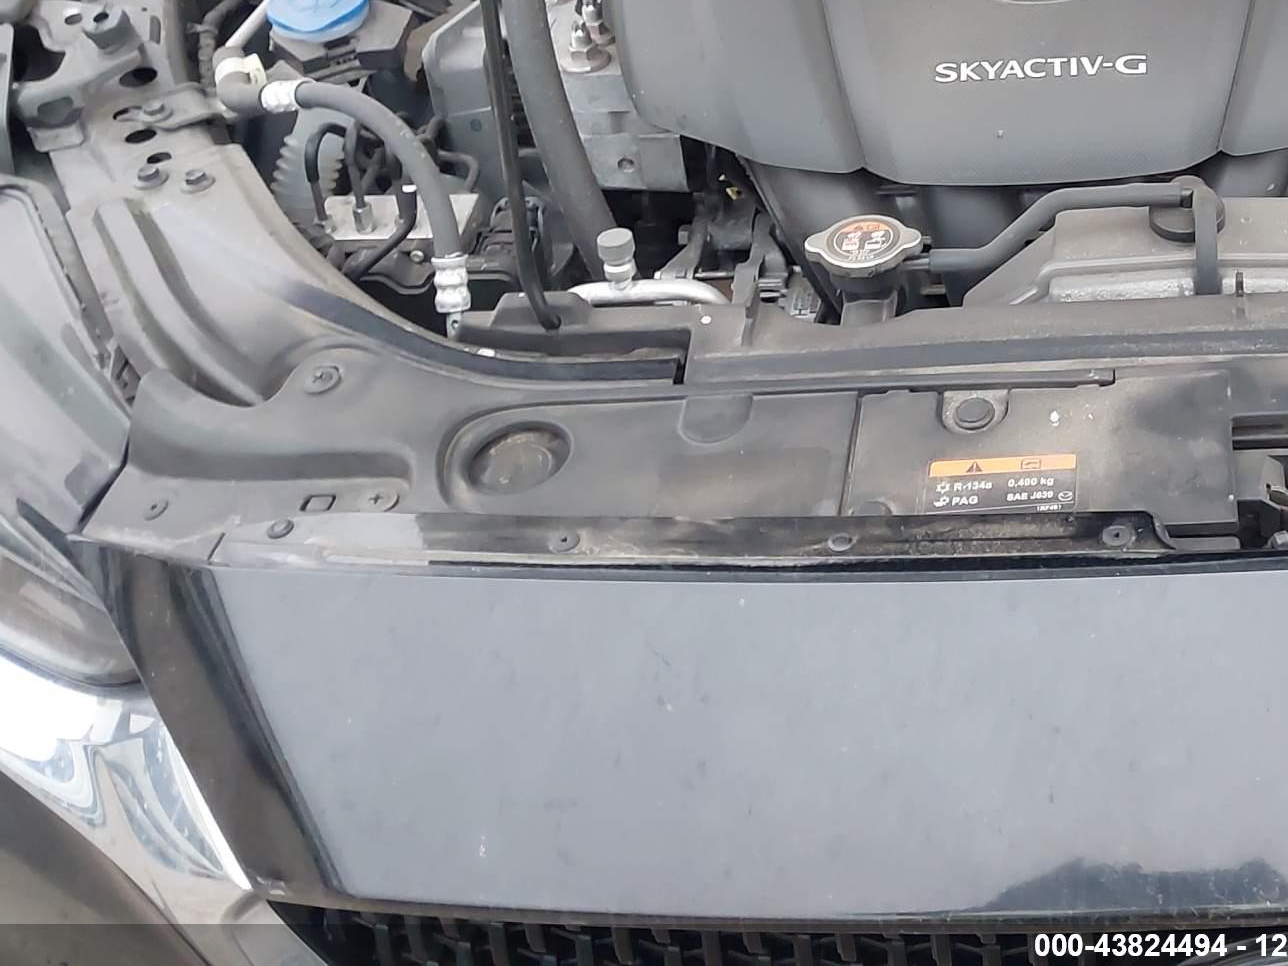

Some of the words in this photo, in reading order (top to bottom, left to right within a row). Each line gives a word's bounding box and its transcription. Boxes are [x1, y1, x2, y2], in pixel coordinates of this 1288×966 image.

[935, 54, 1148, 83] SKYACTIV-G
[1039, 477, 1054, 487] kg
[951, 496, 978, 506] PAG
[1006, 493, 1028, 502] SAE
